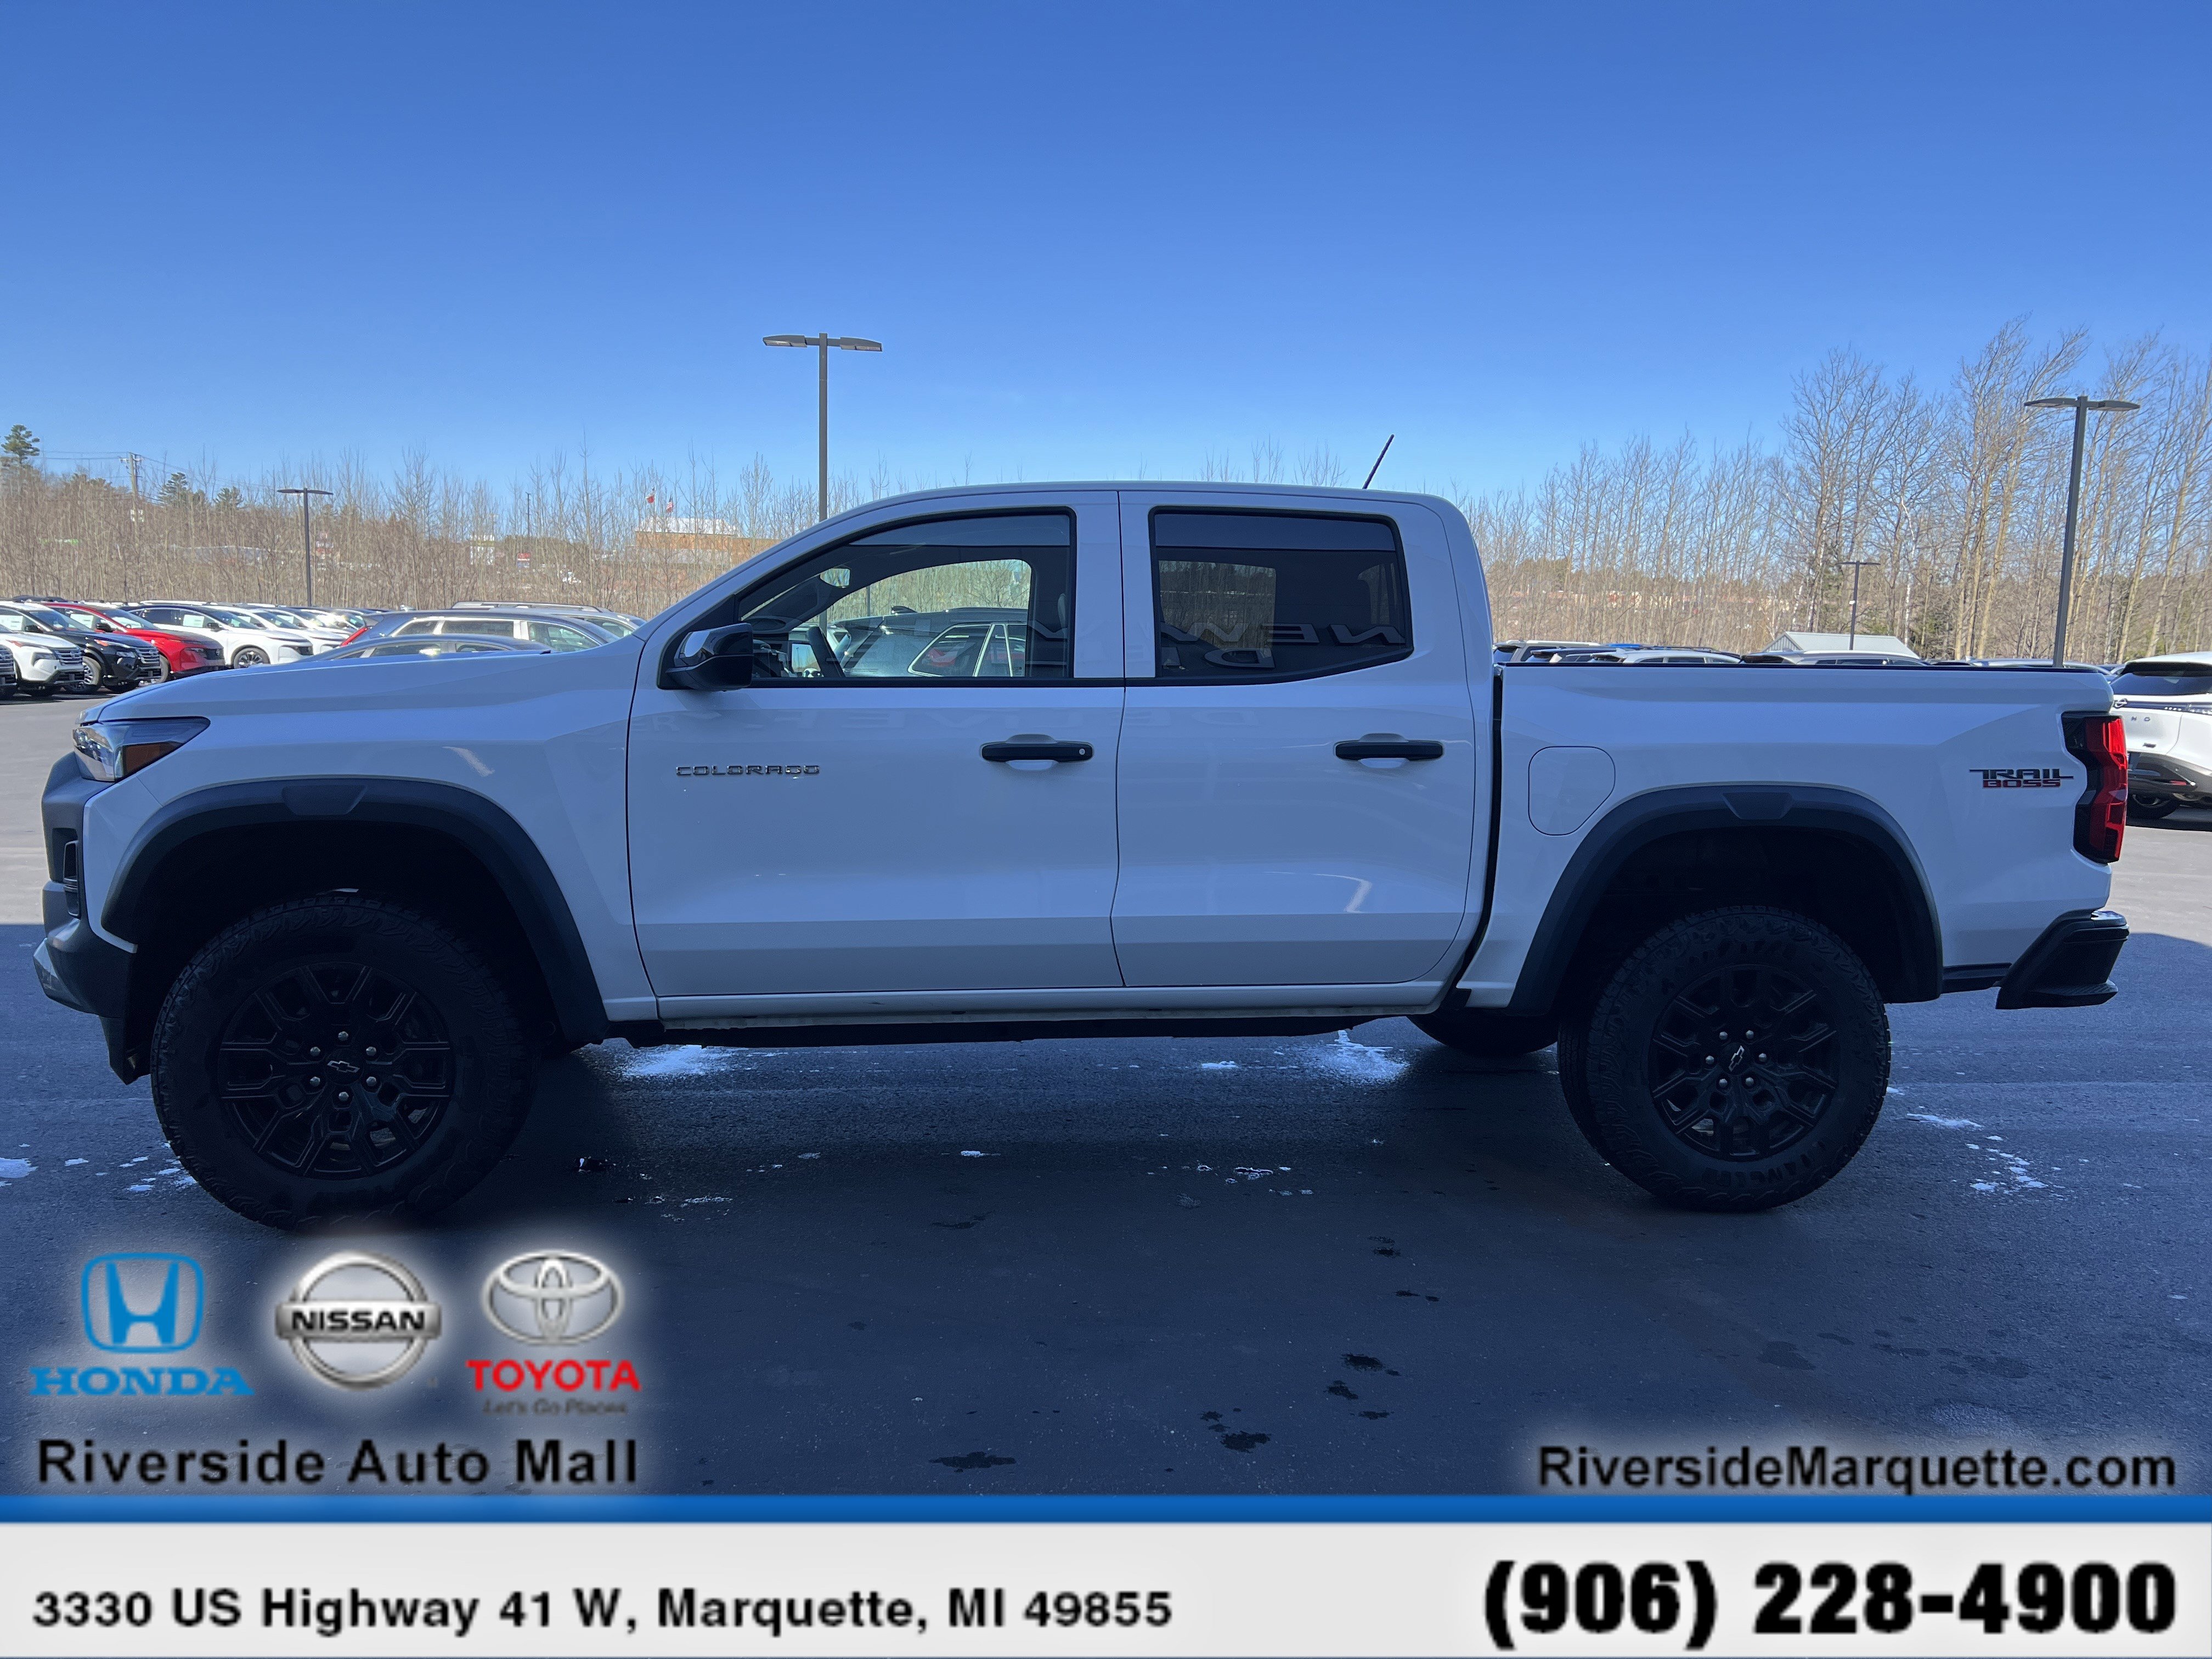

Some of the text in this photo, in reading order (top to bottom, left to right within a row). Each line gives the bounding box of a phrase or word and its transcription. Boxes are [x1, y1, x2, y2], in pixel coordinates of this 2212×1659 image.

[676, 765, 820, 776] COLORADO
[1969, 769, 2074, 780] TRAIL
[1982, 779, 2061, 788] BOSS
